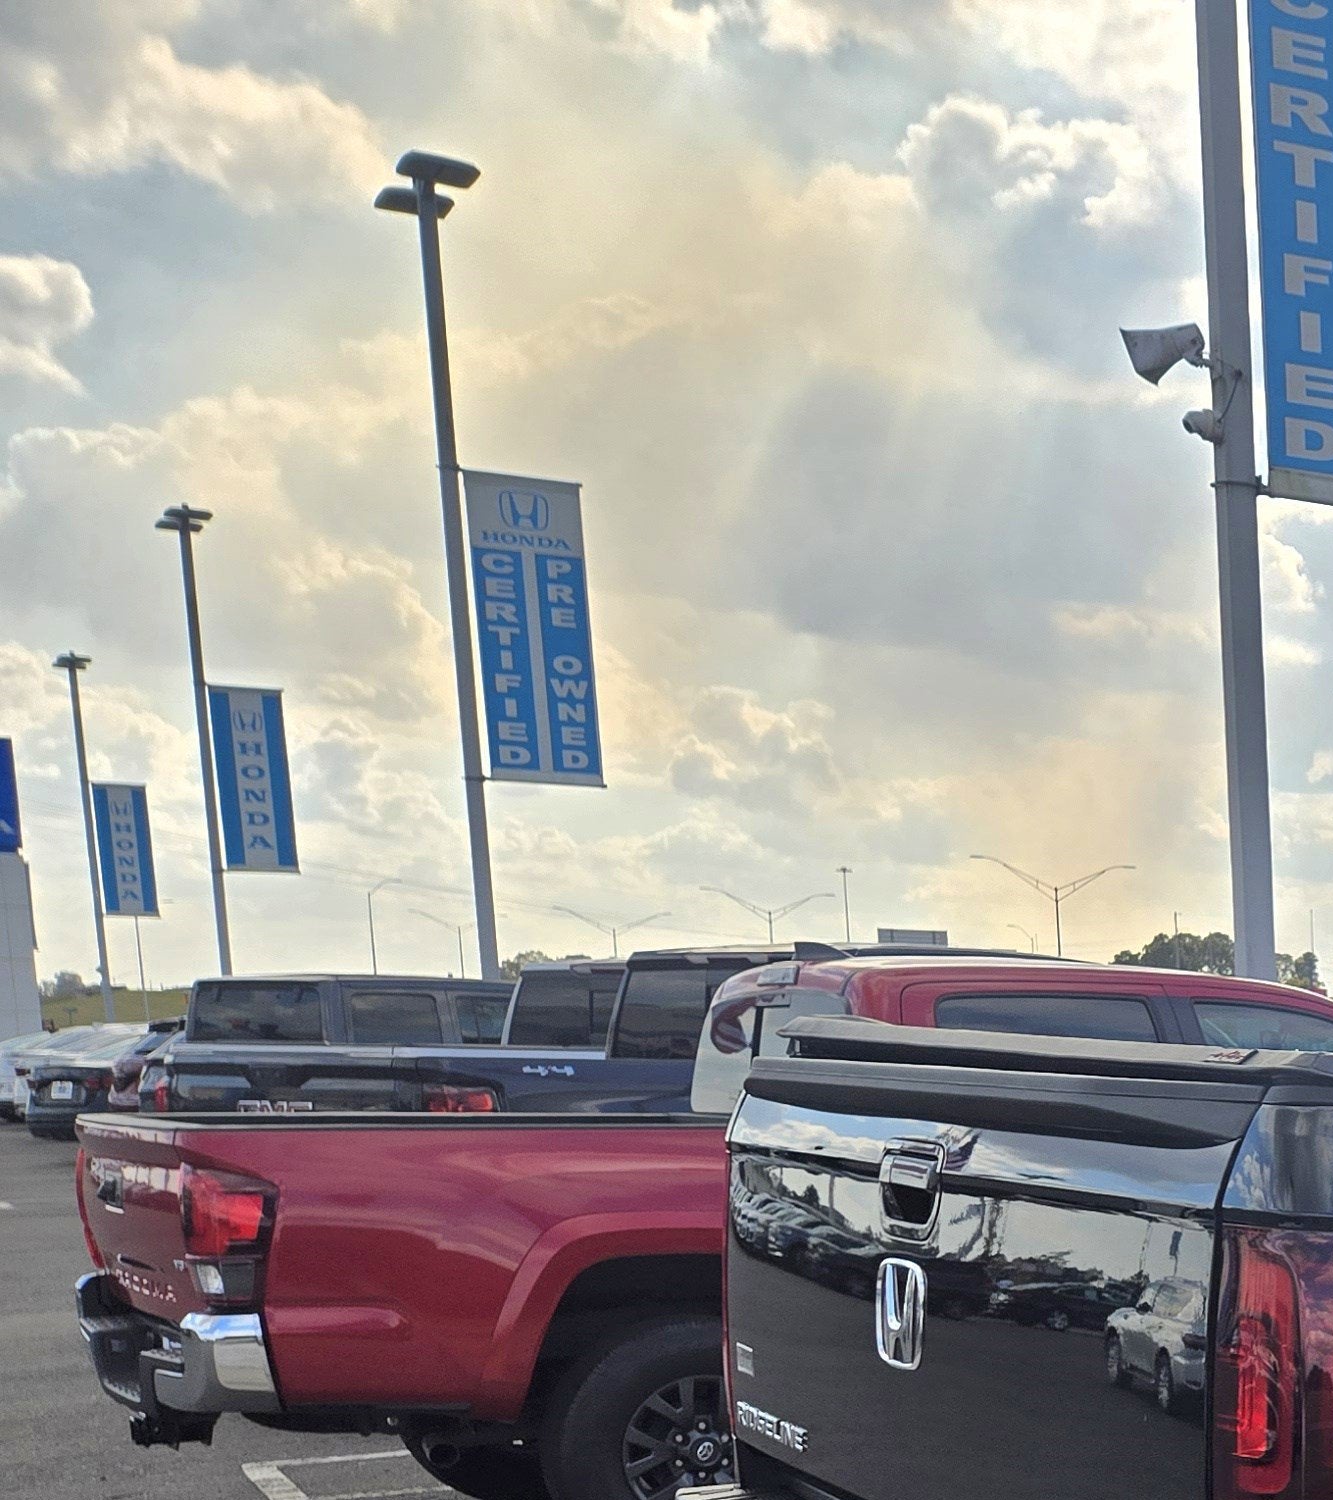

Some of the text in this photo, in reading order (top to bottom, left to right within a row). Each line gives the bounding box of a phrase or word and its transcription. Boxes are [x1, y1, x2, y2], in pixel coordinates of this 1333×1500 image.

[479, 529, 573, 551] HONDA
[480, 552, 532, 767] CERTIFIED
[546, 558, 590, 771] PRE OWNED
[237, 740, 273, 851] HONDA
[113, 821, 139, 901] HONDA
[736, 1400, 809, 1453] RIDGELINE
